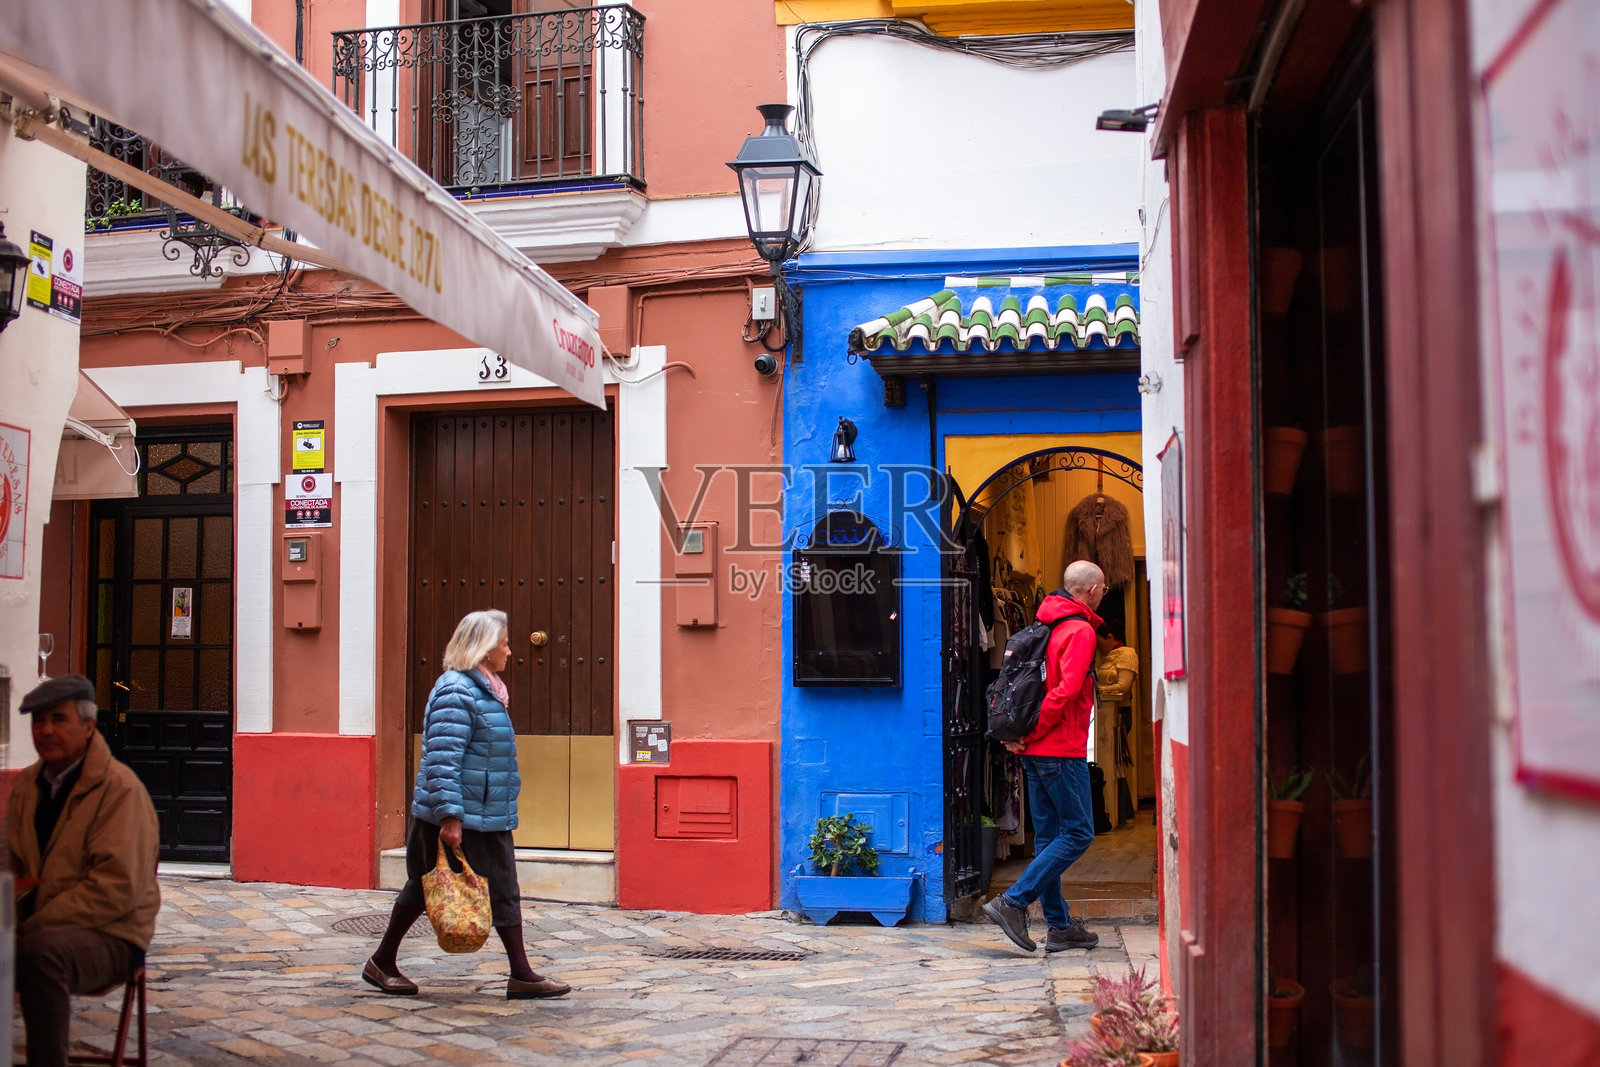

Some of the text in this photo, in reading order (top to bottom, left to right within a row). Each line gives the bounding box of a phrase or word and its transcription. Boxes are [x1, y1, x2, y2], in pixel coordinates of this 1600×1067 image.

[242, 91, 277, 184] LAS
[286, 124, 356, 238] TERESAS
[409, 218, 442, 294] 1870
